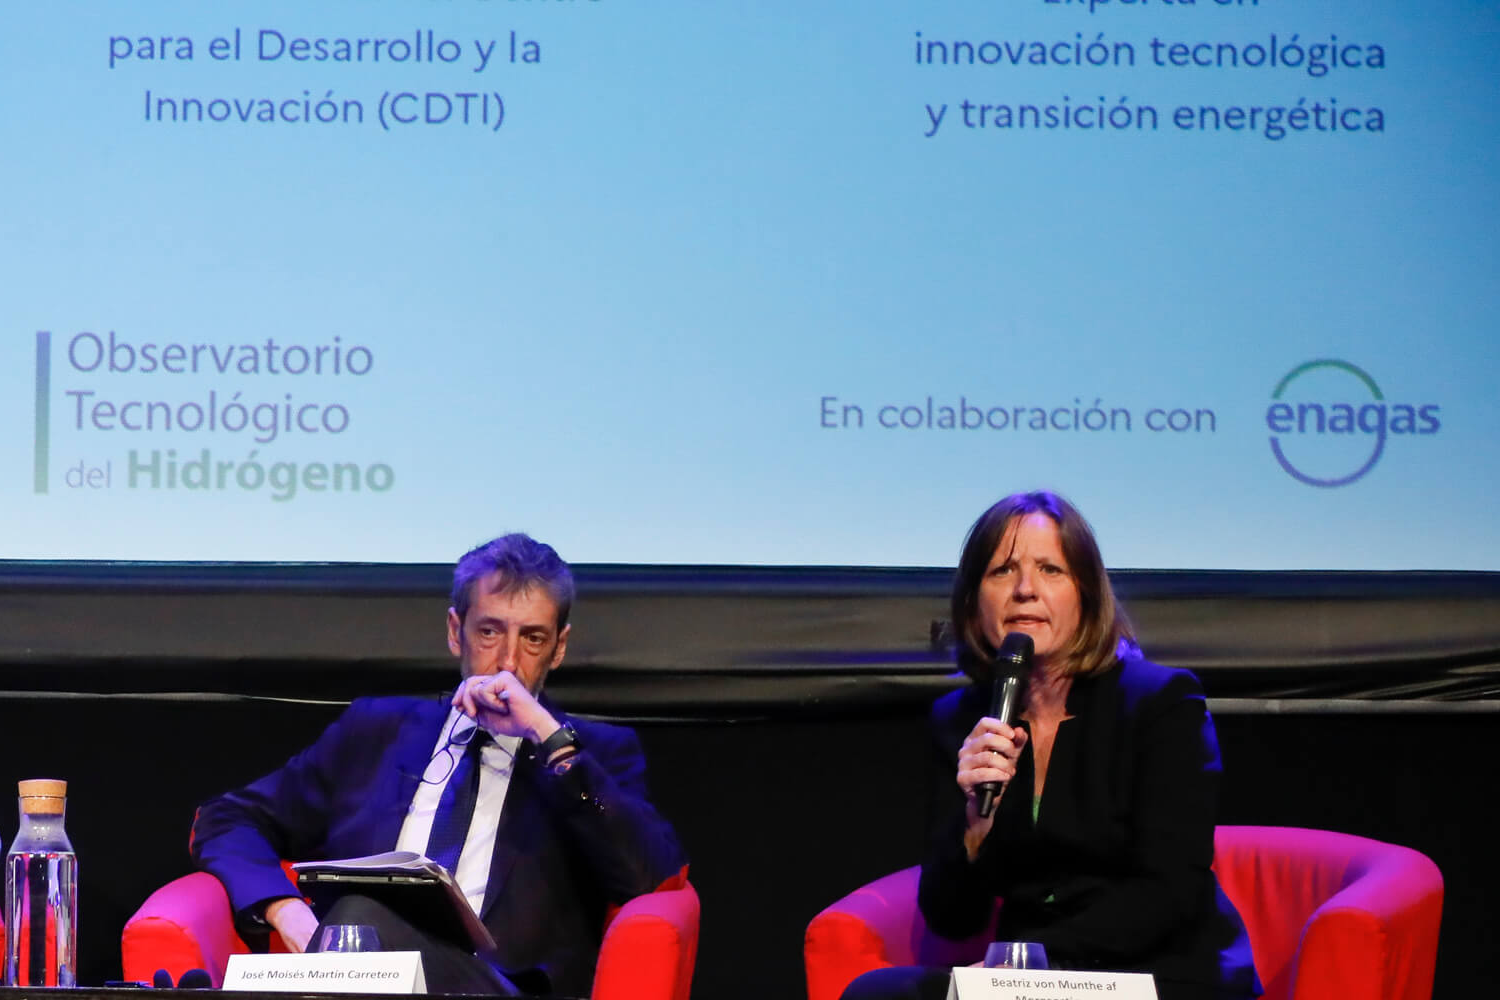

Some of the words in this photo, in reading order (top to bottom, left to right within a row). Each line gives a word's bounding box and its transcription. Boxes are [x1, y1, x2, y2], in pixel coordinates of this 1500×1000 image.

[109, 37, 193, 69] para
[209, 28, 240, 61] el
[258, 29, 461, 63] Desarrollo
[474, 40, 496, 73] y
[510, 31, 540, 64] la
[916, 32, 1135, 66] innovación
[1150, 34, 1386, 78] tecnológica
[145, 90, 363, 123] Innovación
[378, 91, 505, 132] (CDTI)
[925, 104, 948, 138] y
[960, 96, 1158, 130] transición
[1173, 97, 1385, 141] energética
[68, 331, 373, 376] Observatorio
[66, 390, 350, 444] Tecnológico
[821, 396, 863, 428] En
[878, 396, 1132, 432] colaboración
[1145, 408, 1216, 432] con
[1266, 401, 1442, 446] enagas
[65, 459, 111, 489] del
[128, 448, 395, 502] Hidrógeno
[241, 970, 265, 980] José
[266, 969, 305, 979] Moisés
[307, 969, 345, 979] Martín
[347, 969, 400, 979] Carretero
[990, 977, 1032, 989] Beatriz
[1033, 980, 1056, 989] von
[1057, 979, 1104, 991] Munthe
[1106, 981, 1118, 992] af
